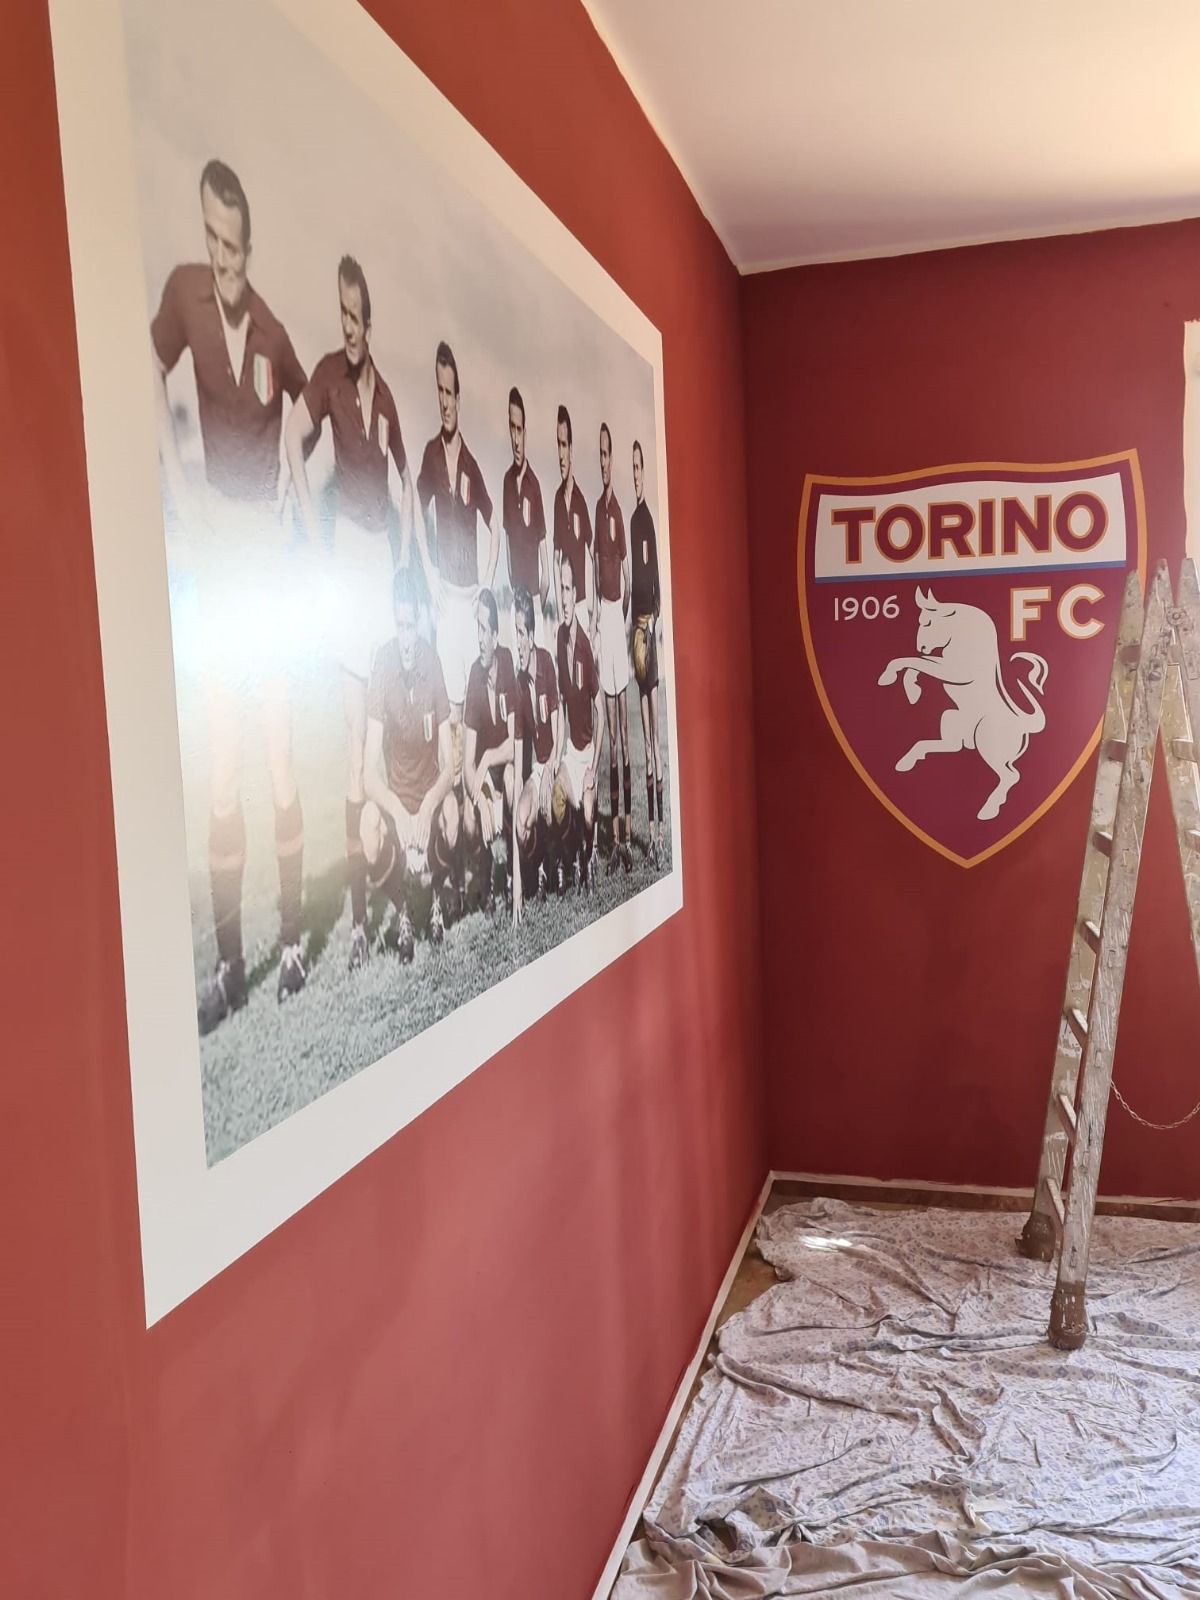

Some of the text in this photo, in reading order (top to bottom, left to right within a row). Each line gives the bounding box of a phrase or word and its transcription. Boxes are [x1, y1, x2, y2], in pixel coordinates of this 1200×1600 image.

[831, 491, 1109, 564] TORINO
[834, 595, 900, 621] 1906
[1010, 584, 1105, 641] FC
